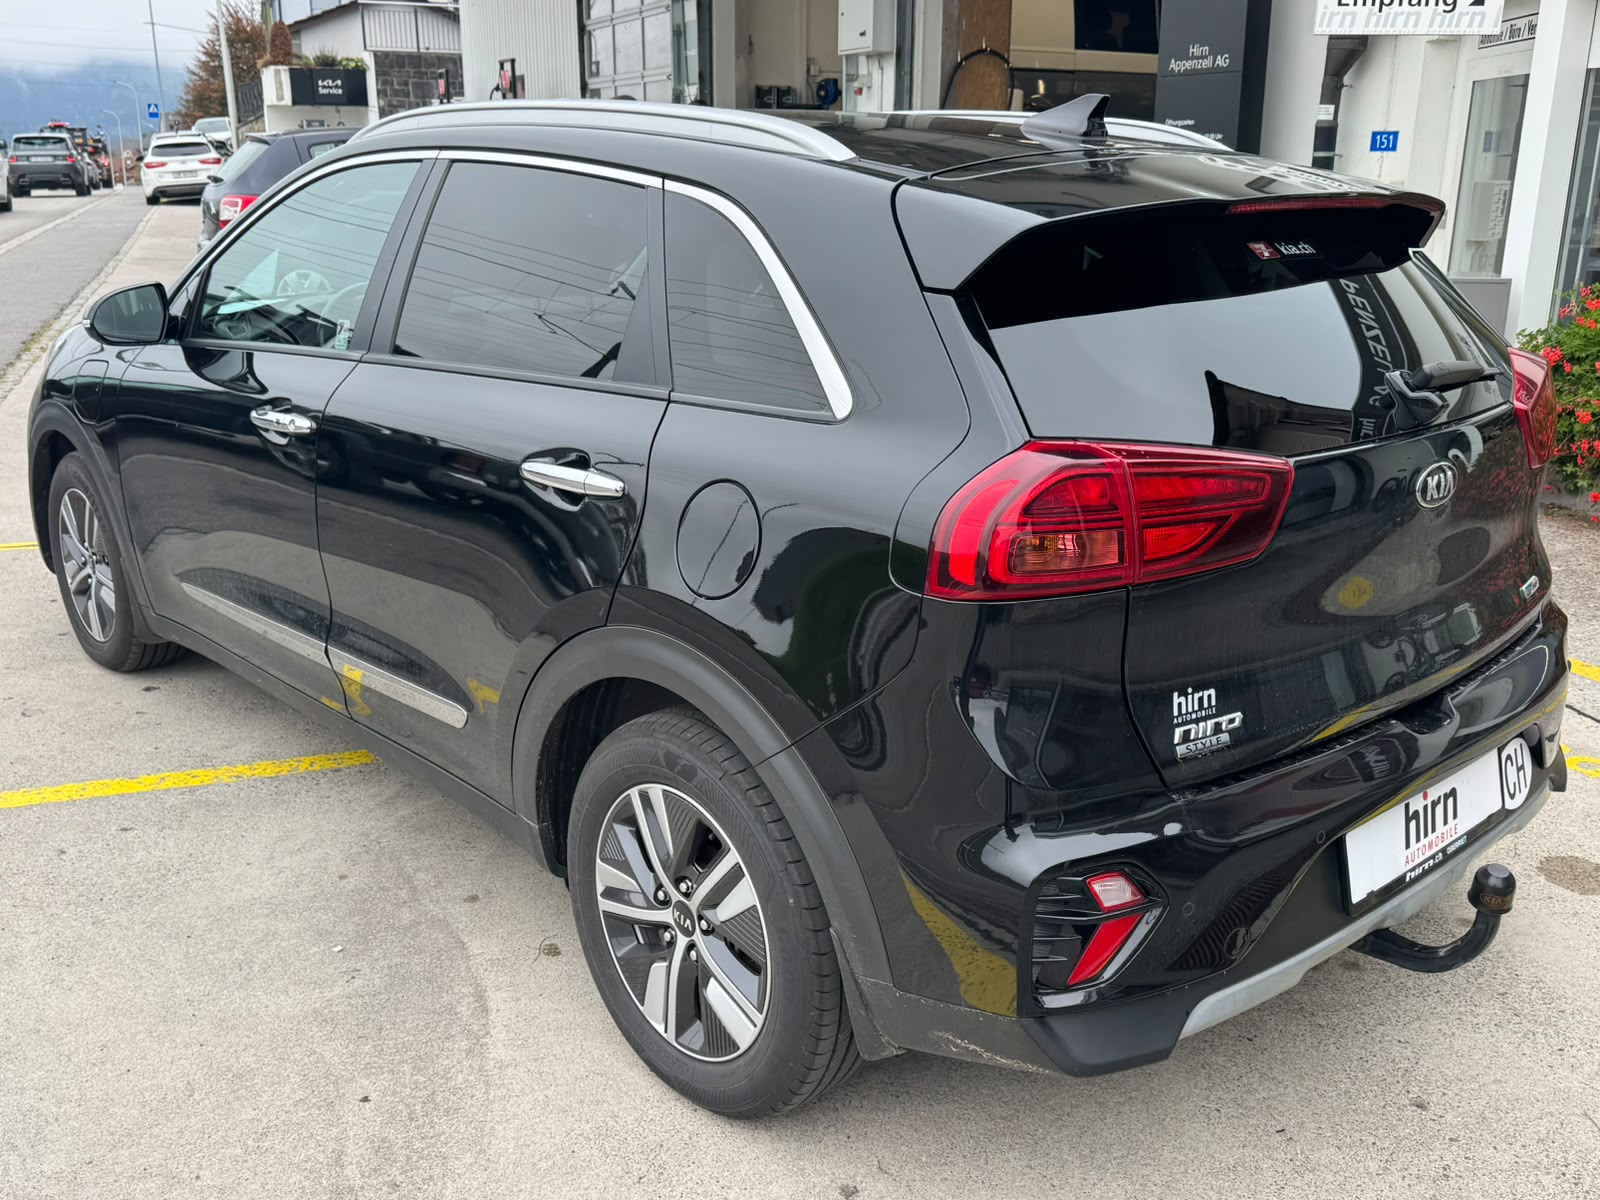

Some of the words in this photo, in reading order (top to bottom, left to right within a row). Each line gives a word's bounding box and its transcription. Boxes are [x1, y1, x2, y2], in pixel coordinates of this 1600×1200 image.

[1189, 44, 1209, 57] Hirn
[1168, 55, 1213, 73] Appenzell
[1214, 54, 1230, 68] AG
[318, 87, 343, 95] Service
[1375, 134, 1394, 149] 151
[1274, 241, 1317, 255] kia.ch
[1426, 471, 1454, 500] KIA
[1173, 687, 1216, 716] hirn
[1173, 707, 1217, 724] AUTOMOBILE
[1185, 736, 1223, 753] STYLE
[1504, 743, 1528, 800] CH
[1404, 786, 1458, 850] hirn
[1405, 823, 1458, 867] AUTOMOBILE
[1405, 852, 1443, 883] hirn.ch
[674, 908, 692, 931] KIA
